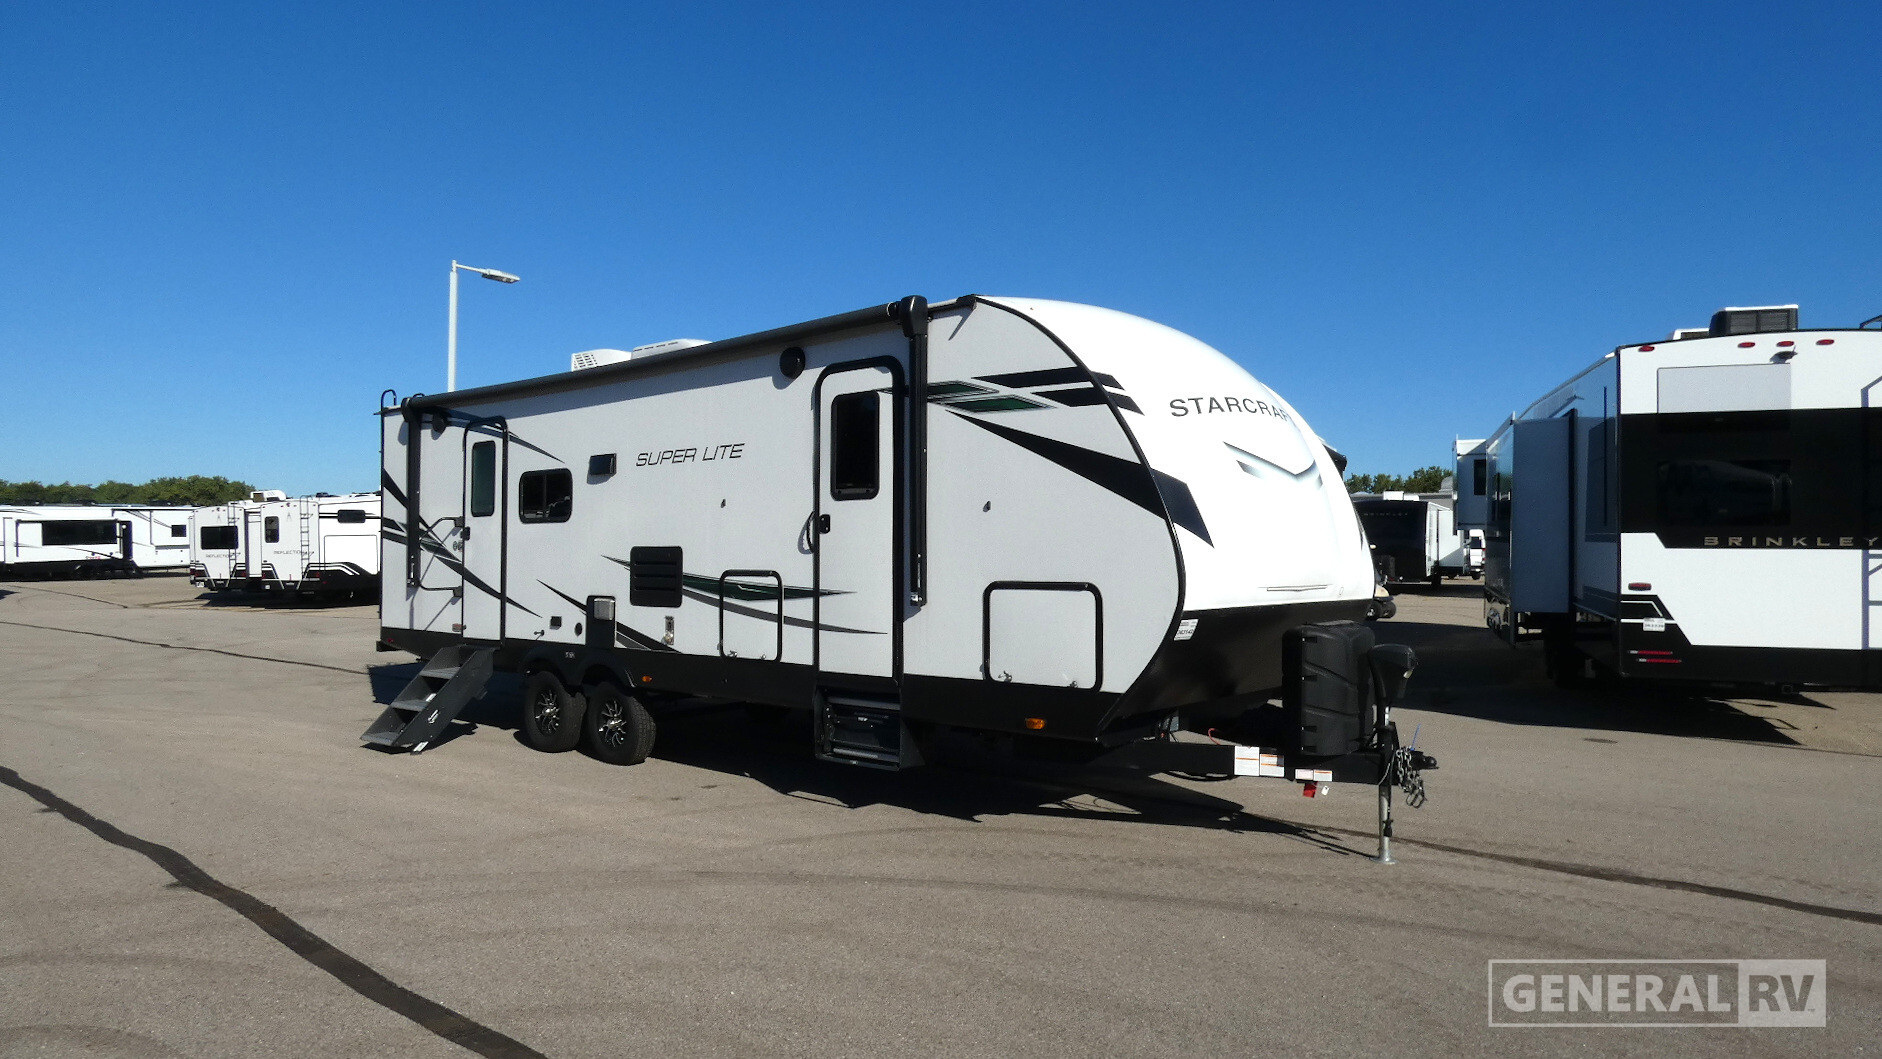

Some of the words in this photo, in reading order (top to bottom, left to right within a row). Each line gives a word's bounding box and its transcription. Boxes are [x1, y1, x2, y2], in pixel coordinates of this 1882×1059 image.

[1169, 397, 1288, 421] STARCRAF
[636, 447, 697, 467] SUPER
[702, 443, 745, 461] LITE
[1704, 536, 1879, 546] BRINKLEY
